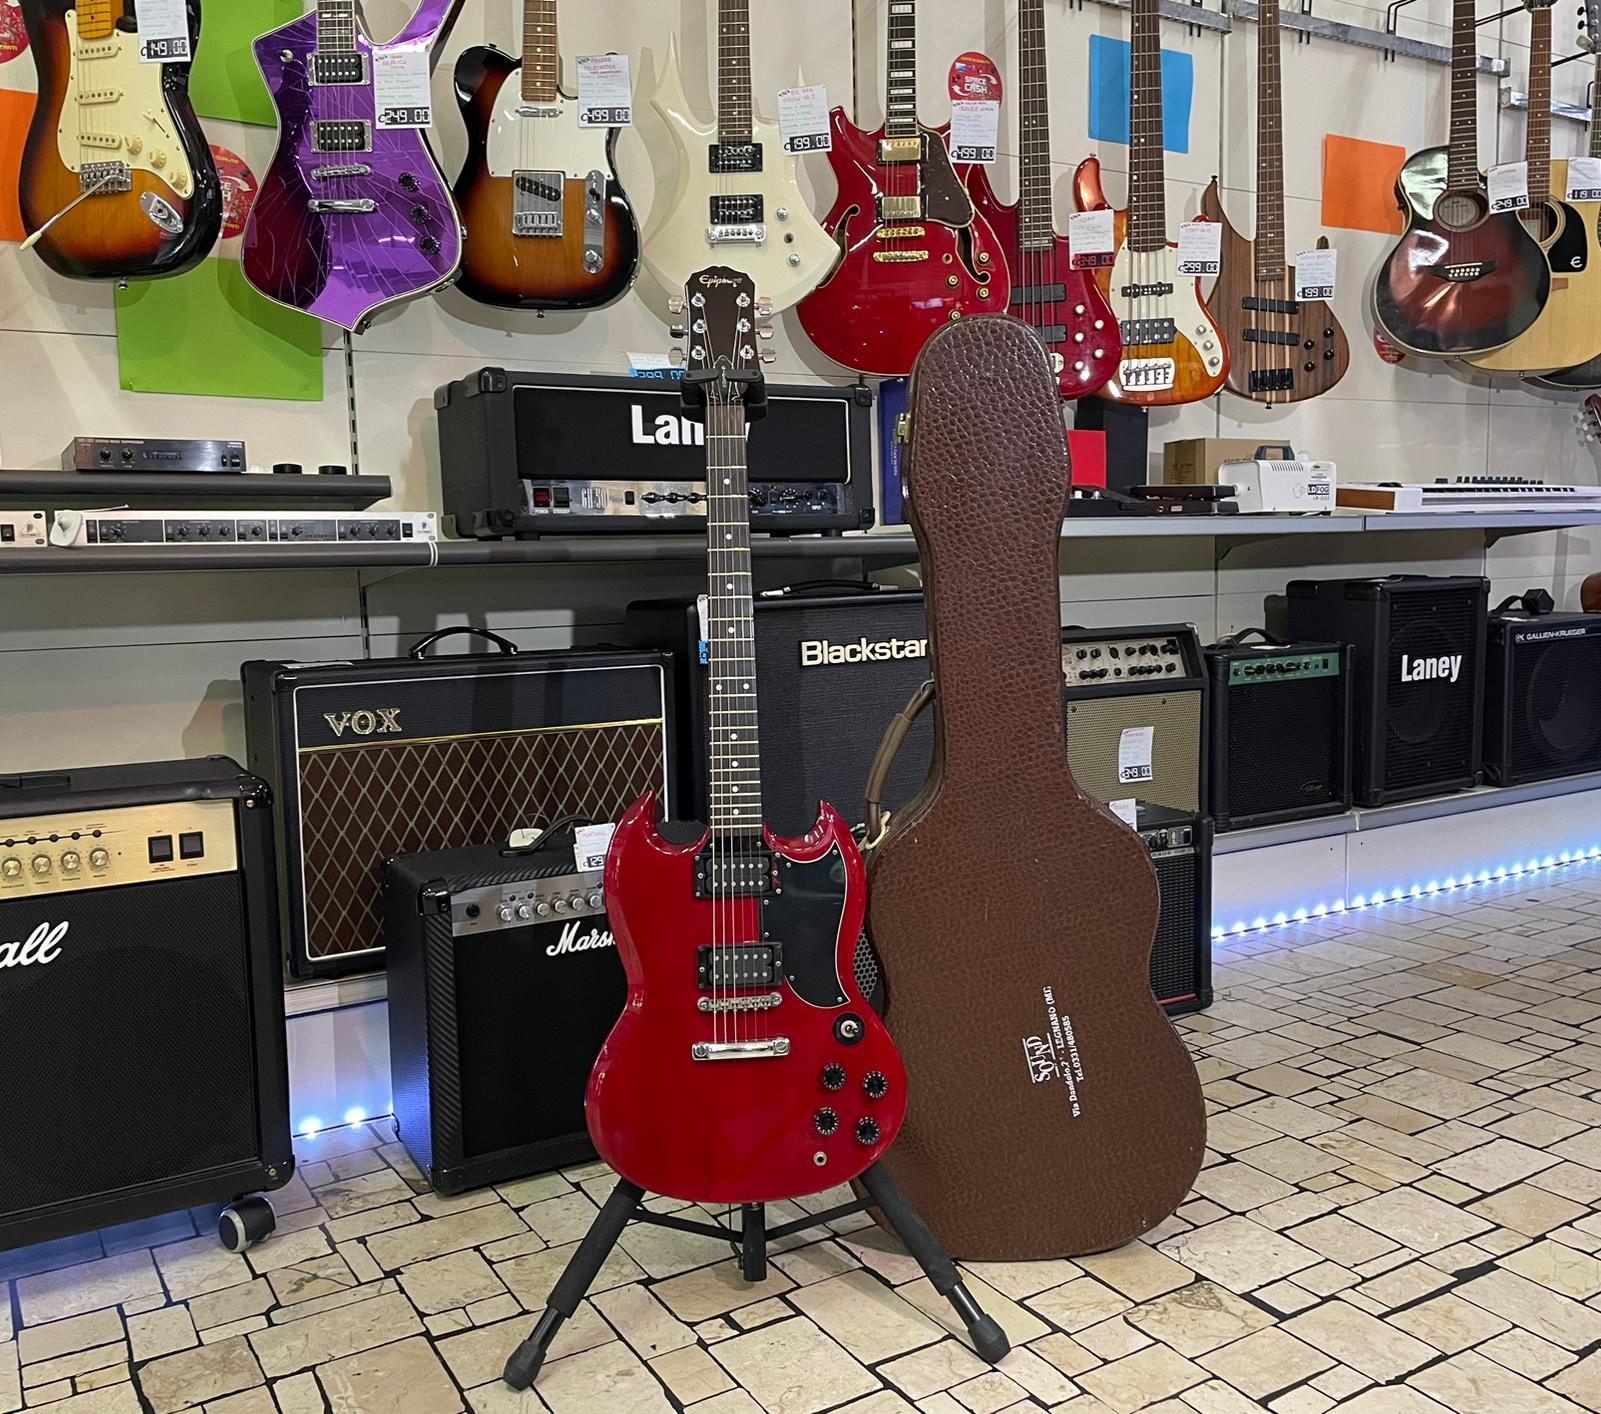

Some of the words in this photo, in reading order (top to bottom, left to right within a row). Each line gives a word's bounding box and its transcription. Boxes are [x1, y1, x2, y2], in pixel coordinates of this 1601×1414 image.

[964, 76, 988, 86] SPACE
[964, 84, 988, 95] CASH
[631, 405, 750, 446] Lan
[801, 638, 928, 666] Blackstar
[1401, 654, 1462, 683] Laney
[323, 708, 402, 737] VOX
[1047, 1006, 1065, 1049] LEGNANO
[1026, 1035, 1054, 1082] SOUND
[1072, 1103, 1081, 1117] Via
